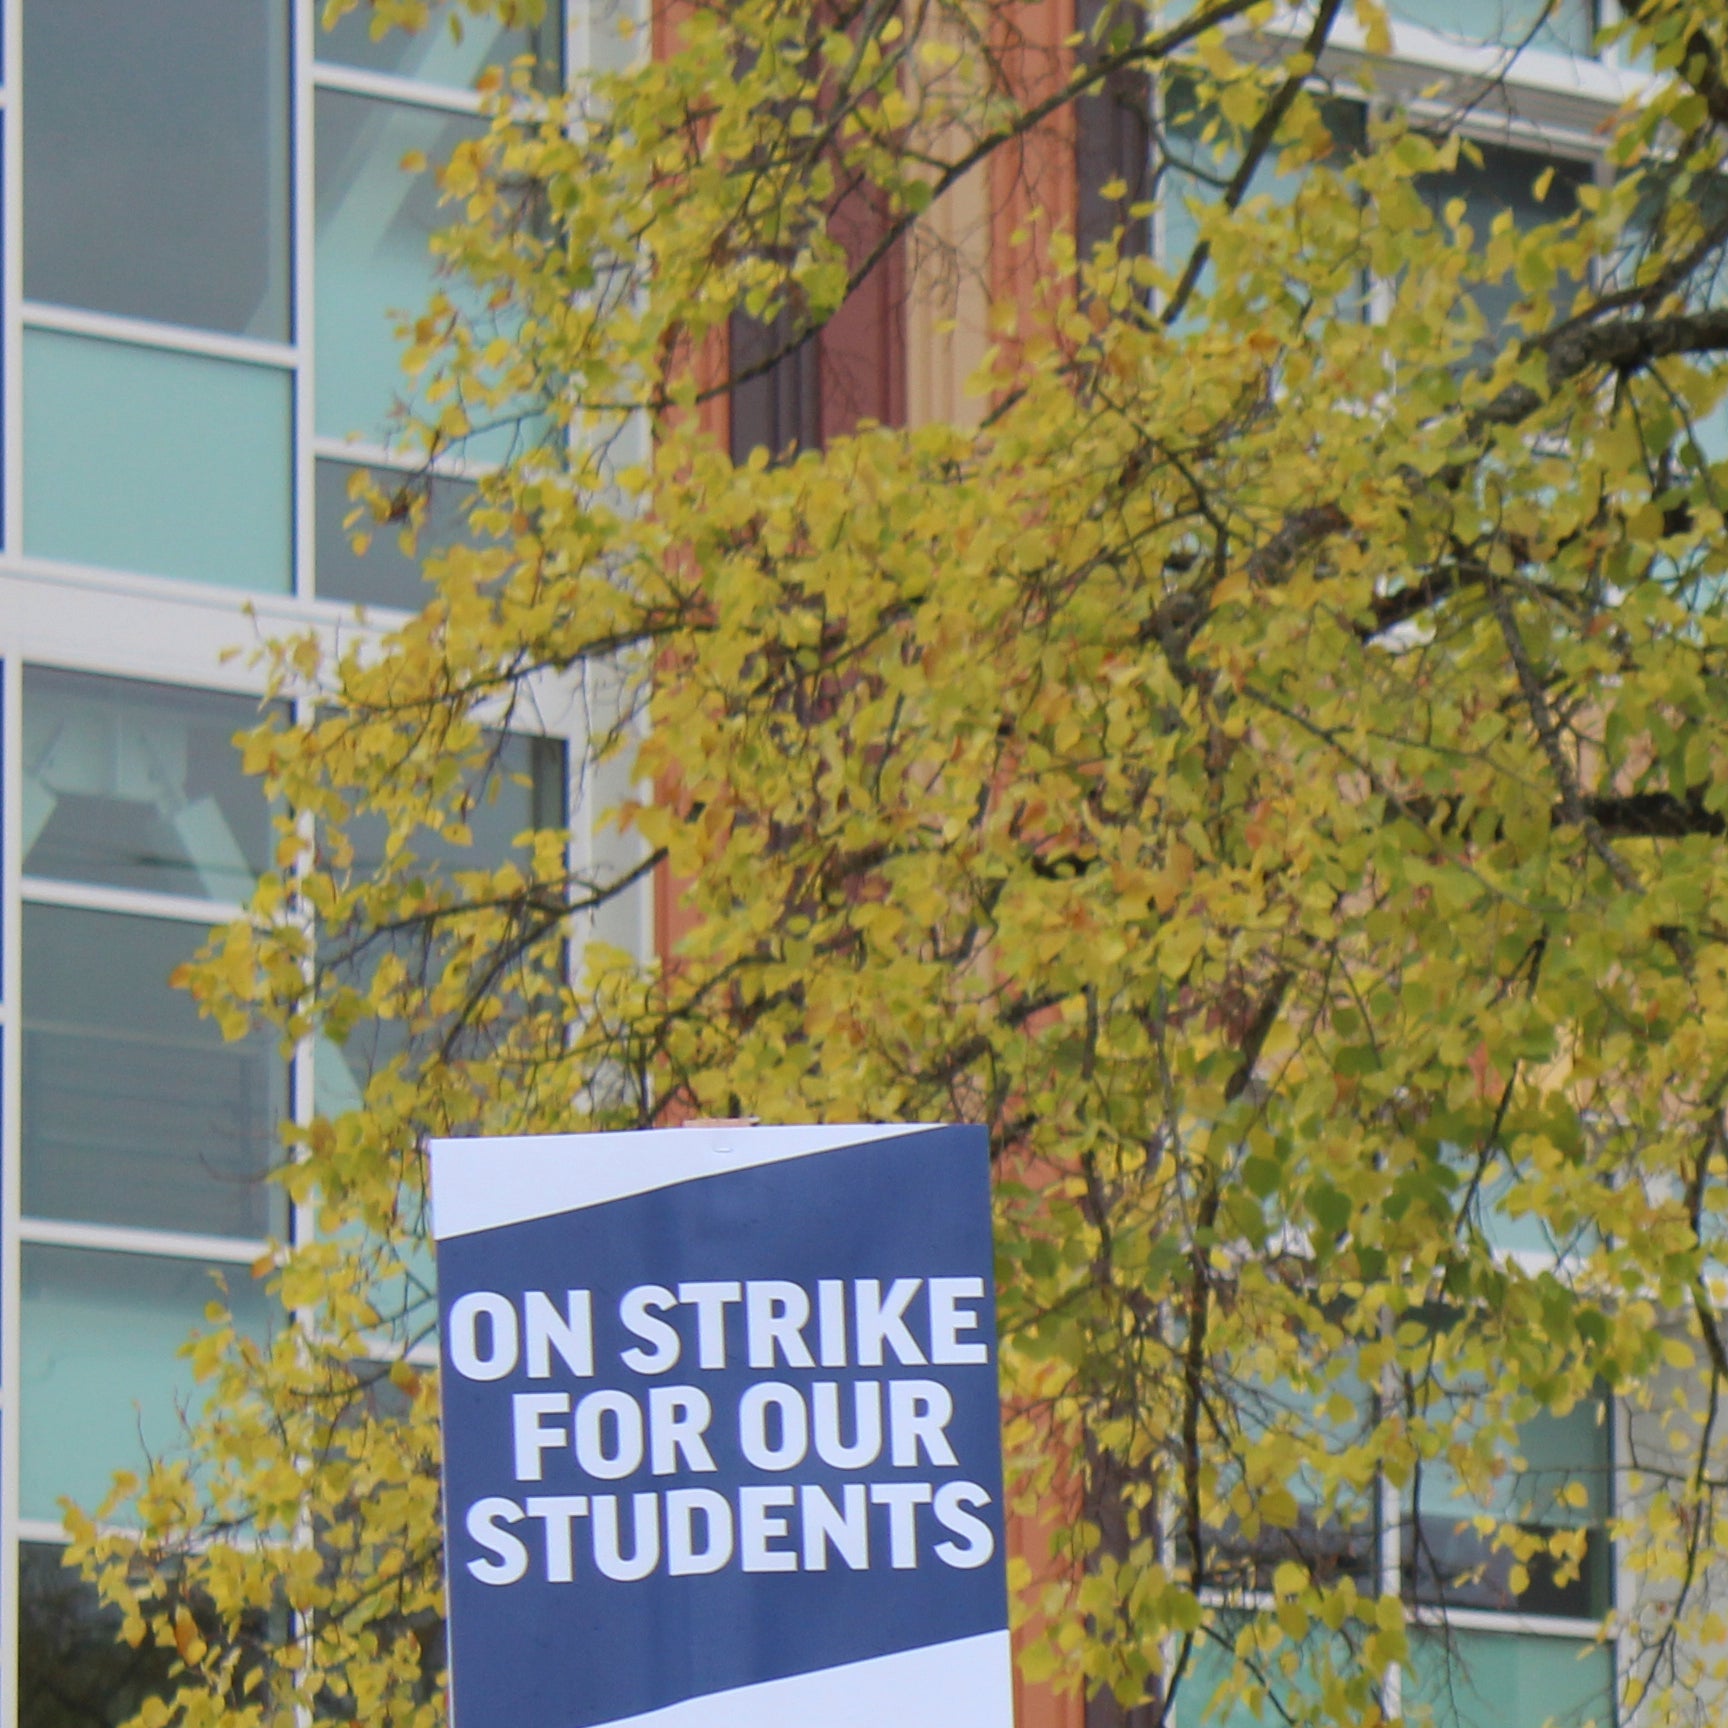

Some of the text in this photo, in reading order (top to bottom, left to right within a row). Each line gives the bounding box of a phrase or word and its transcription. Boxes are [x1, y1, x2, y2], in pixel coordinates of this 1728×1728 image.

[448, 1275, 989, 1381] ON STRIKE
[512, 1378, 959, 1482] FOR OUR
[465, 1480, 996, 1586] STUDENTS
